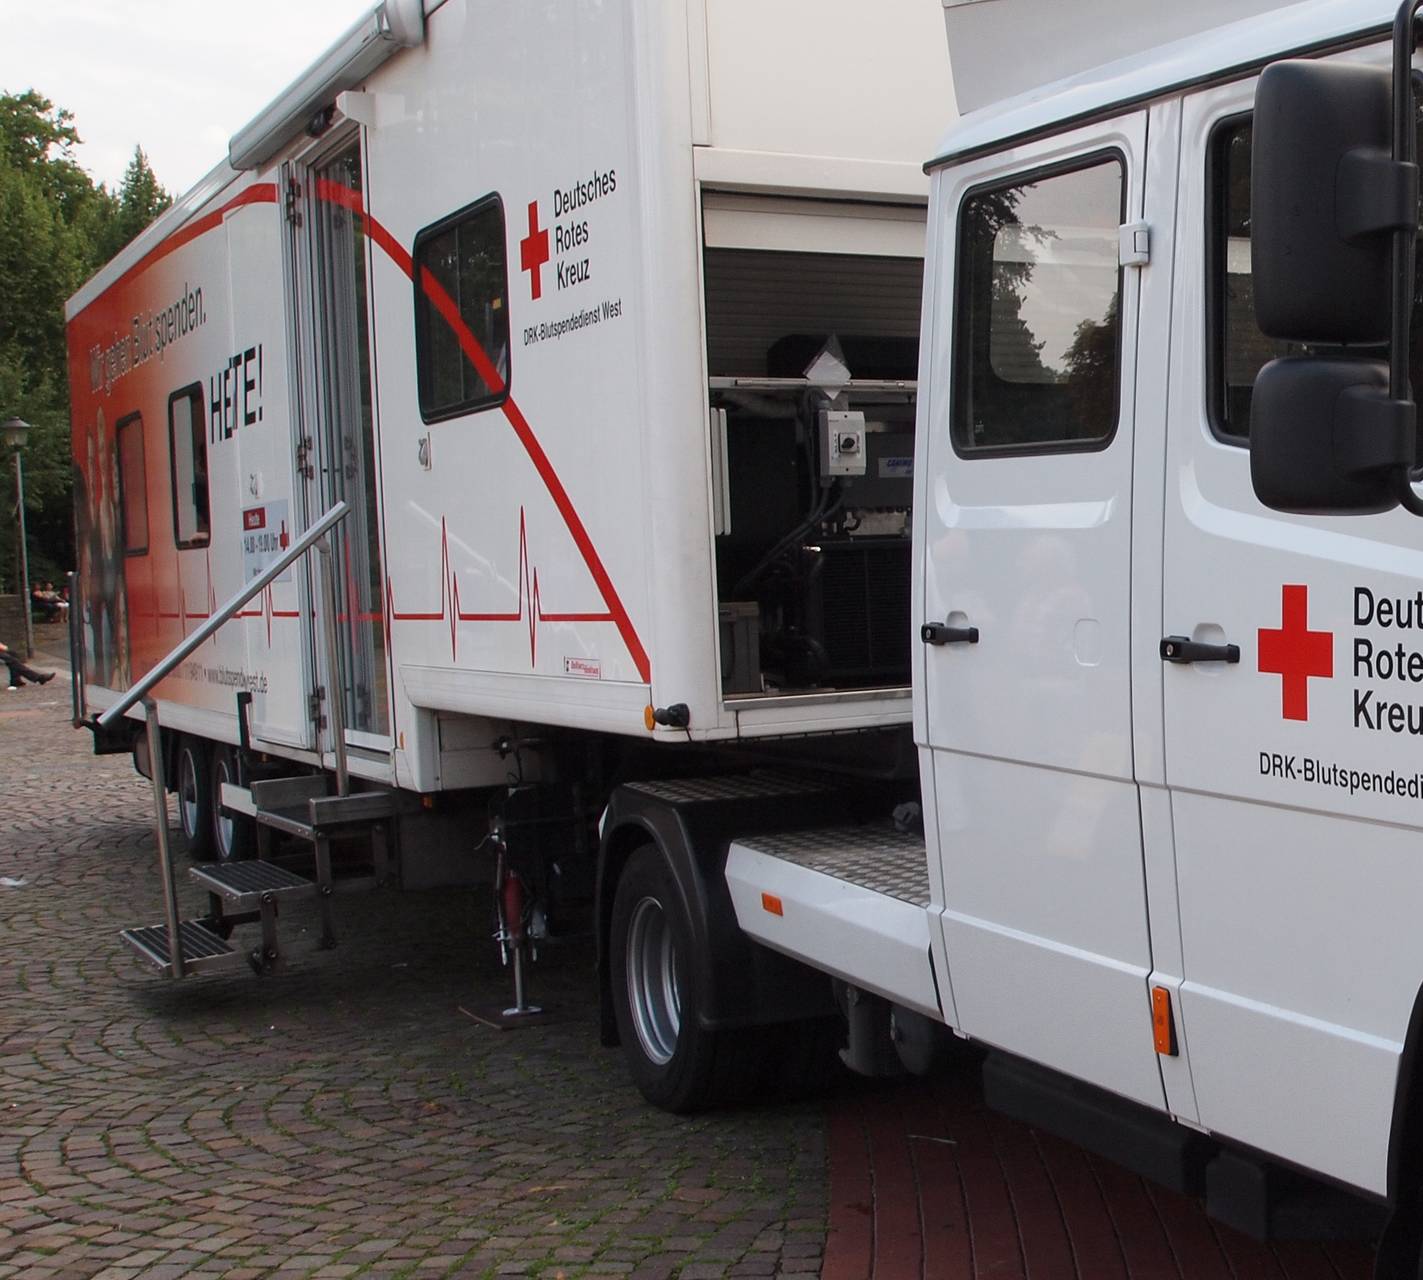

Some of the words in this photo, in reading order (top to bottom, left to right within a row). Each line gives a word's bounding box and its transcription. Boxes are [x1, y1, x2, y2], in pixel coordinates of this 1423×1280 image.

[554, 169, 617, 218] Deutsches
[555, 220, 589, 255] Rotes
[556, 258, 591, 291] Kreuz
[155, 281, 207, 365] spenden.
[523, 305, 601, 347] DRK-Blutspendedienst
[601, 298, 623, 321] West
